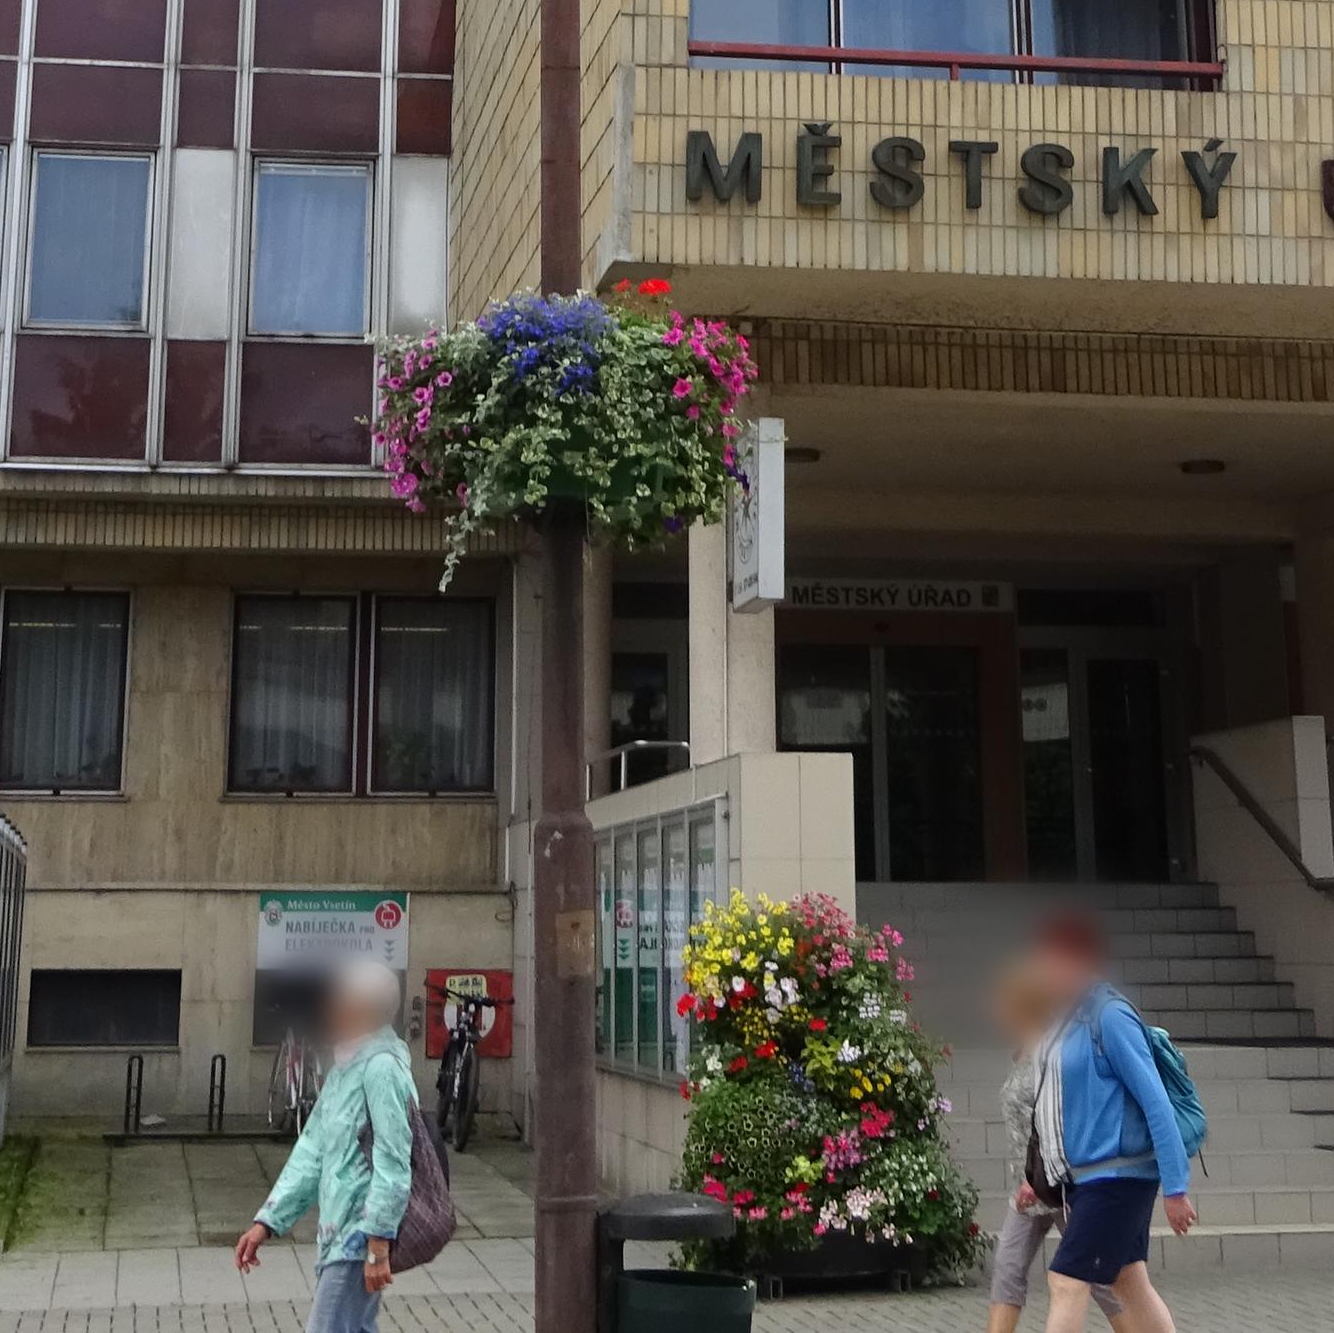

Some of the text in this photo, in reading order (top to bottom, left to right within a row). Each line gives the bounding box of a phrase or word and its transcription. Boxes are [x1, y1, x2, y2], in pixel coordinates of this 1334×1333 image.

[685, 121, 1238, 219] MĚSTSKÝ
[792, 584, 972, 607] MĚSTSKÝ ÚŘAD
[287, 899, 357, 910] Město Vsetín
[285, 917, 356, 934] NABÍJEČKA
